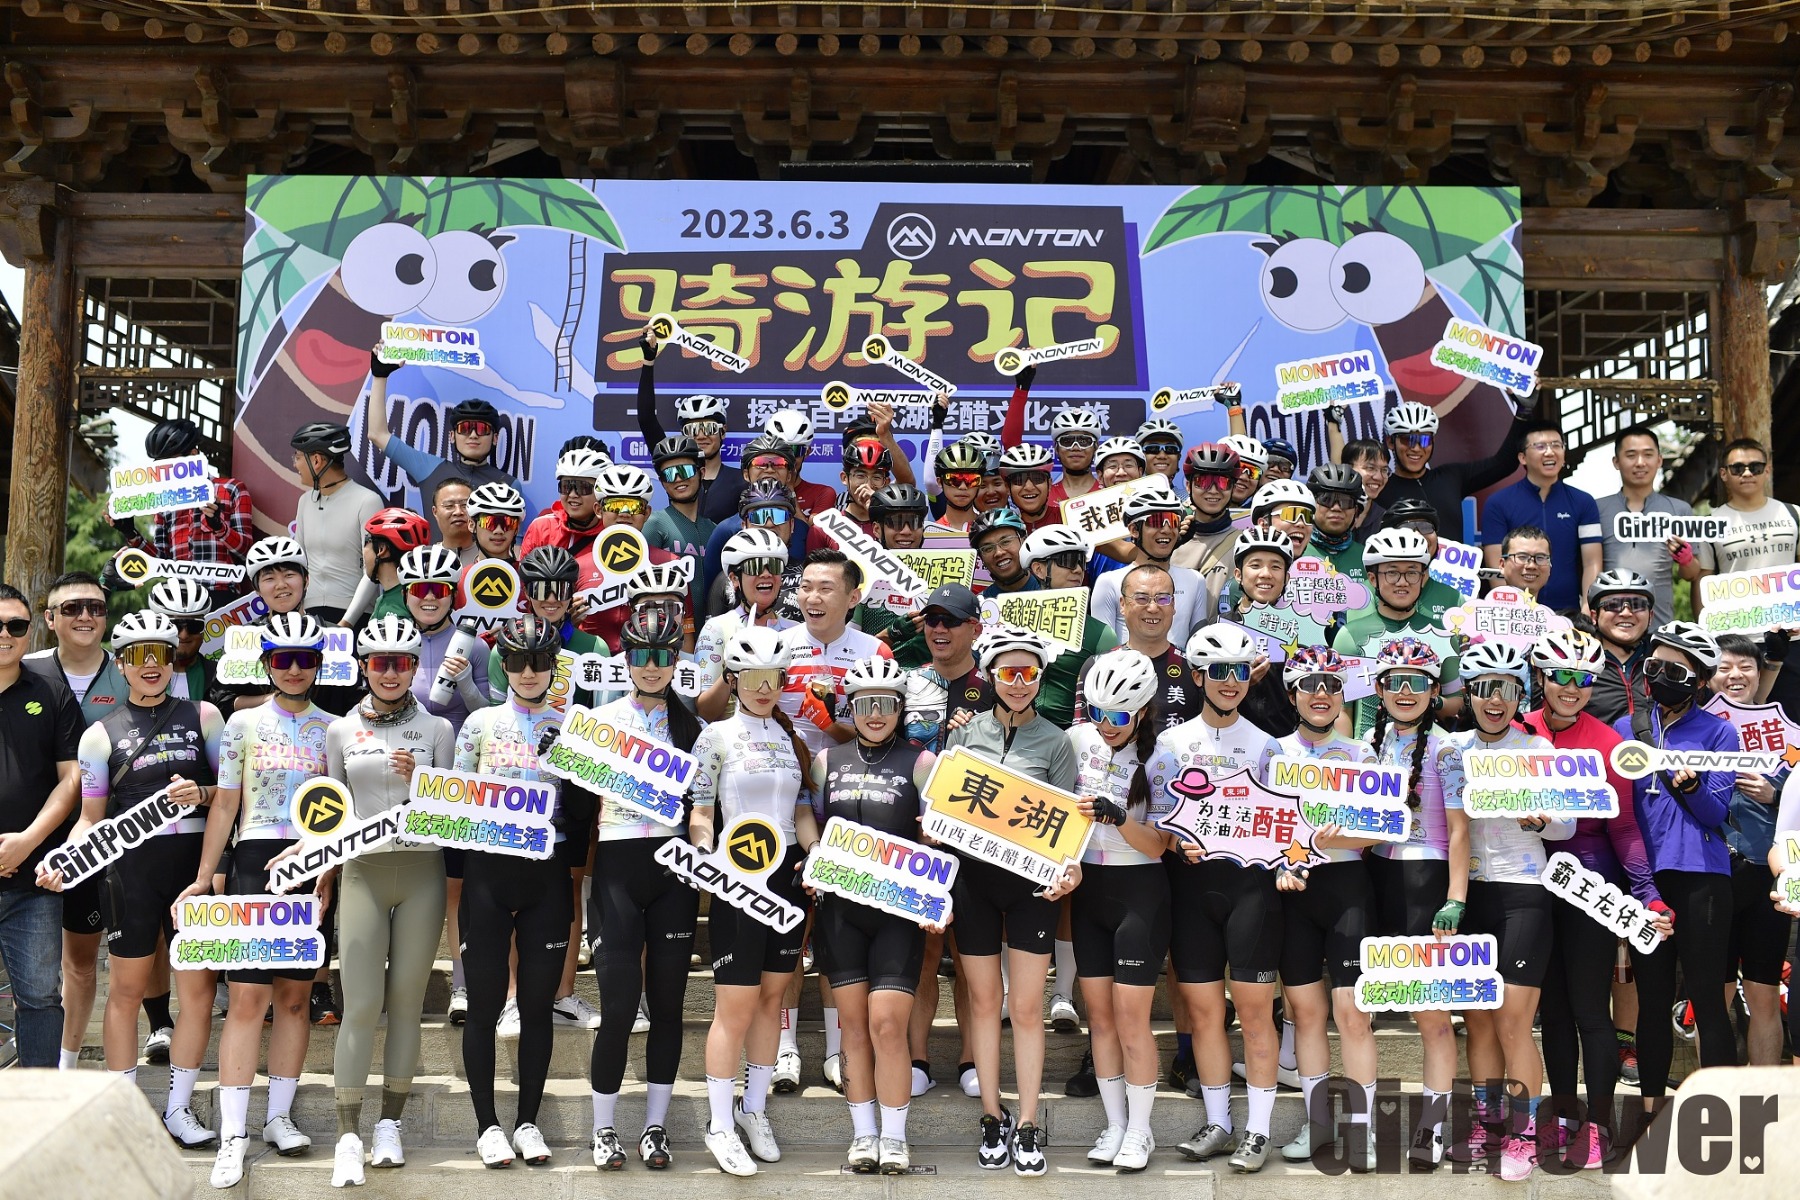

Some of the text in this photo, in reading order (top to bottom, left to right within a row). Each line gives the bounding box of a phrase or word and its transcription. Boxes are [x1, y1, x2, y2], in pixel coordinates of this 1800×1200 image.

[680, 208, 851, 240] 2023.6.3
[948, 227, 1104, 247] MONTON
[602, 257, 1120, 372] 骑游记
[386, 325, 476, 346] MONTON
[1028, 338, 1104, 363] MONTON
[1447, 322, 1537, 367] MONTON
[382, 345, 480, 367] 炫动你的生活
[676, 331, 747, 372] MONTON
[888, 354, 955, 396] MONTON
[1279, 354, 1370, 385] MONTON
[1436, 344, 1533, 393] 炫动你的生活
[856, 391, 933, 404] MONTON
[1281, 377, 1380, 411] 炫动你的生活
[114, 459, 203, 488] MONTON
[113, 484, 210, 514] 炫动你的生活
[1618, 516, 1728, 539] GirlPower
[1727, 519, 1793, 536] RFORMANCE
[818, 512, 922, 593] MONTON
[157, 561, 244, 580] MONTON
[1707, 569, 1800, 601] MONTO
[203, 596, 270, 643] ONTO
[1258, 611, 1299, 639] 醋味
[582, 660, 696, 690] 霸王育
[484, 740, 539, 757] SKUL
[567, 711, 692, 784] MONTON
[1740, 718, 1785, 752] 醋
[250, 742, 315, 760] SKULL
[486, 754, 540, 770] MONT
[1193, 754, 1238, 769] SKULL
[1660, 753, 1775, 769] MONTON
[251, 758, 328, 775] MONTON
[547, 743, 682, 820] 炫动你的生活
[1275, 762, 1402, 798] MONTON
[1470, 755, 1600, 778] MONTON
[417, 773, 549, 814] MONTON
[829, 789, 896, 806] MONTON
[948, 768, 1070, 849] 東湖
[1470, 788, 1612, 812] 炫动你的生活
[1198, 800, 1252, 823] 为生活
[405, 809, 549, 853] 炫动你的生活
[827, 823, 953, 884] MONTON
[929, 817, 1057, 884] 山西老陈醋集团
[663, 845, 797, 927] MONTON
[810, 856, 946, 923] 炫动你的生活
[183, 901, 313, 927] MONTON
[1548, 860, 1660, 946] 霸王龙体育
[177, 937, 319, 963] 炫动你的生活
[1367, 941, 1491, 969] MONTON
[1362, 978, 1498, 1006] 炫动你的生活
